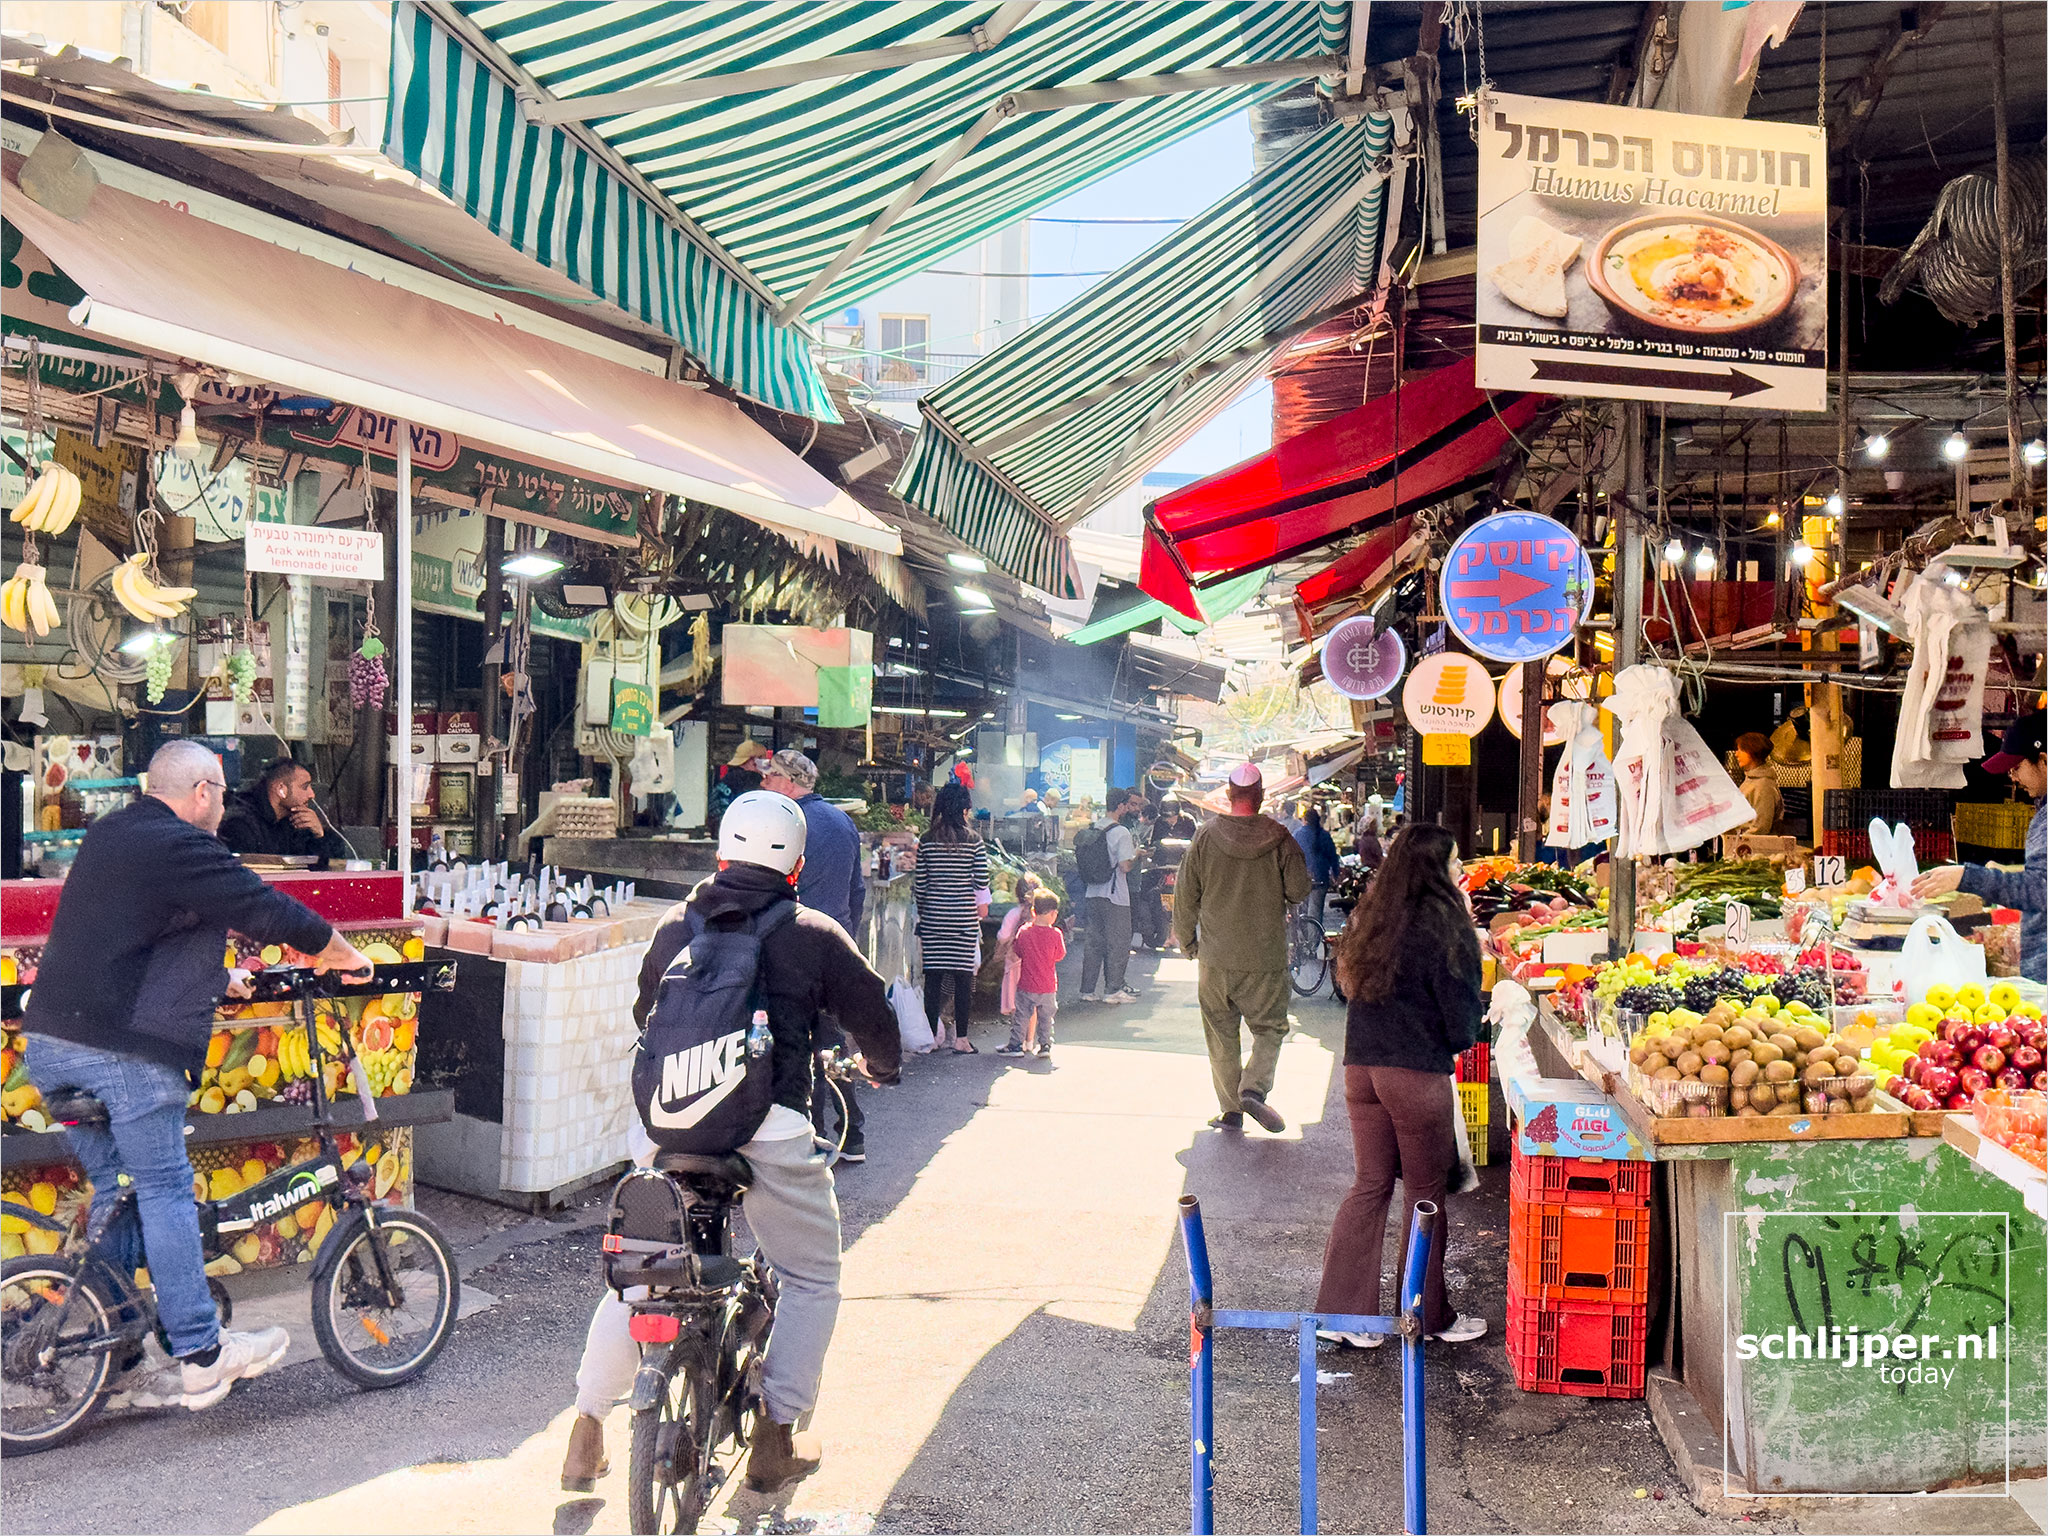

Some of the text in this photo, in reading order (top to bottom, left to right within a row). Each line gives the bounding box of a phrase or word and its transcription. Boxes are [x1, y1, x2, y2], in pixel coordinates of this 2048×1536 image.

[1495, 112, 1810, 188] חומוס הכרמל
[1529, 166, 1780, 216] Humus Hacarmel
[1496, 330, 1523, 342] הבית
[1525, 330, 1560, 345] בישולי
[1606, 336, 1635, 350] פלפל
[1644, 339, 1673, 353] בגריל
[1675, 344, 1694, 356] עוף
[1702, 345, 1740, 358] מסבחה
[1748, 347, 1766, 360] פול
[1775, 351, 1806, 363] חומוס
[253, 526, 289, 541] טבעית
[293, 531, 335, 545] לימונדה
[338, 535, 353, 547] עם
[356, 537, 377, 550] ערק
[265, 544, 363, 562] Arak with natural
[1458, 538, 1577, 575] קיוסק
[271, 557, 358, 574] lemonade juice
[1458, 606, 1578, 635] הכרמל
[1420, 704, 1476, 721] קיורטוש
[1817, 856, 1844, 886] 12
[1727, 903, 1749, 944] 20
[661, 1028, 746, 1104] NIKE
[250, 1181, 318, 1222] Italwin
